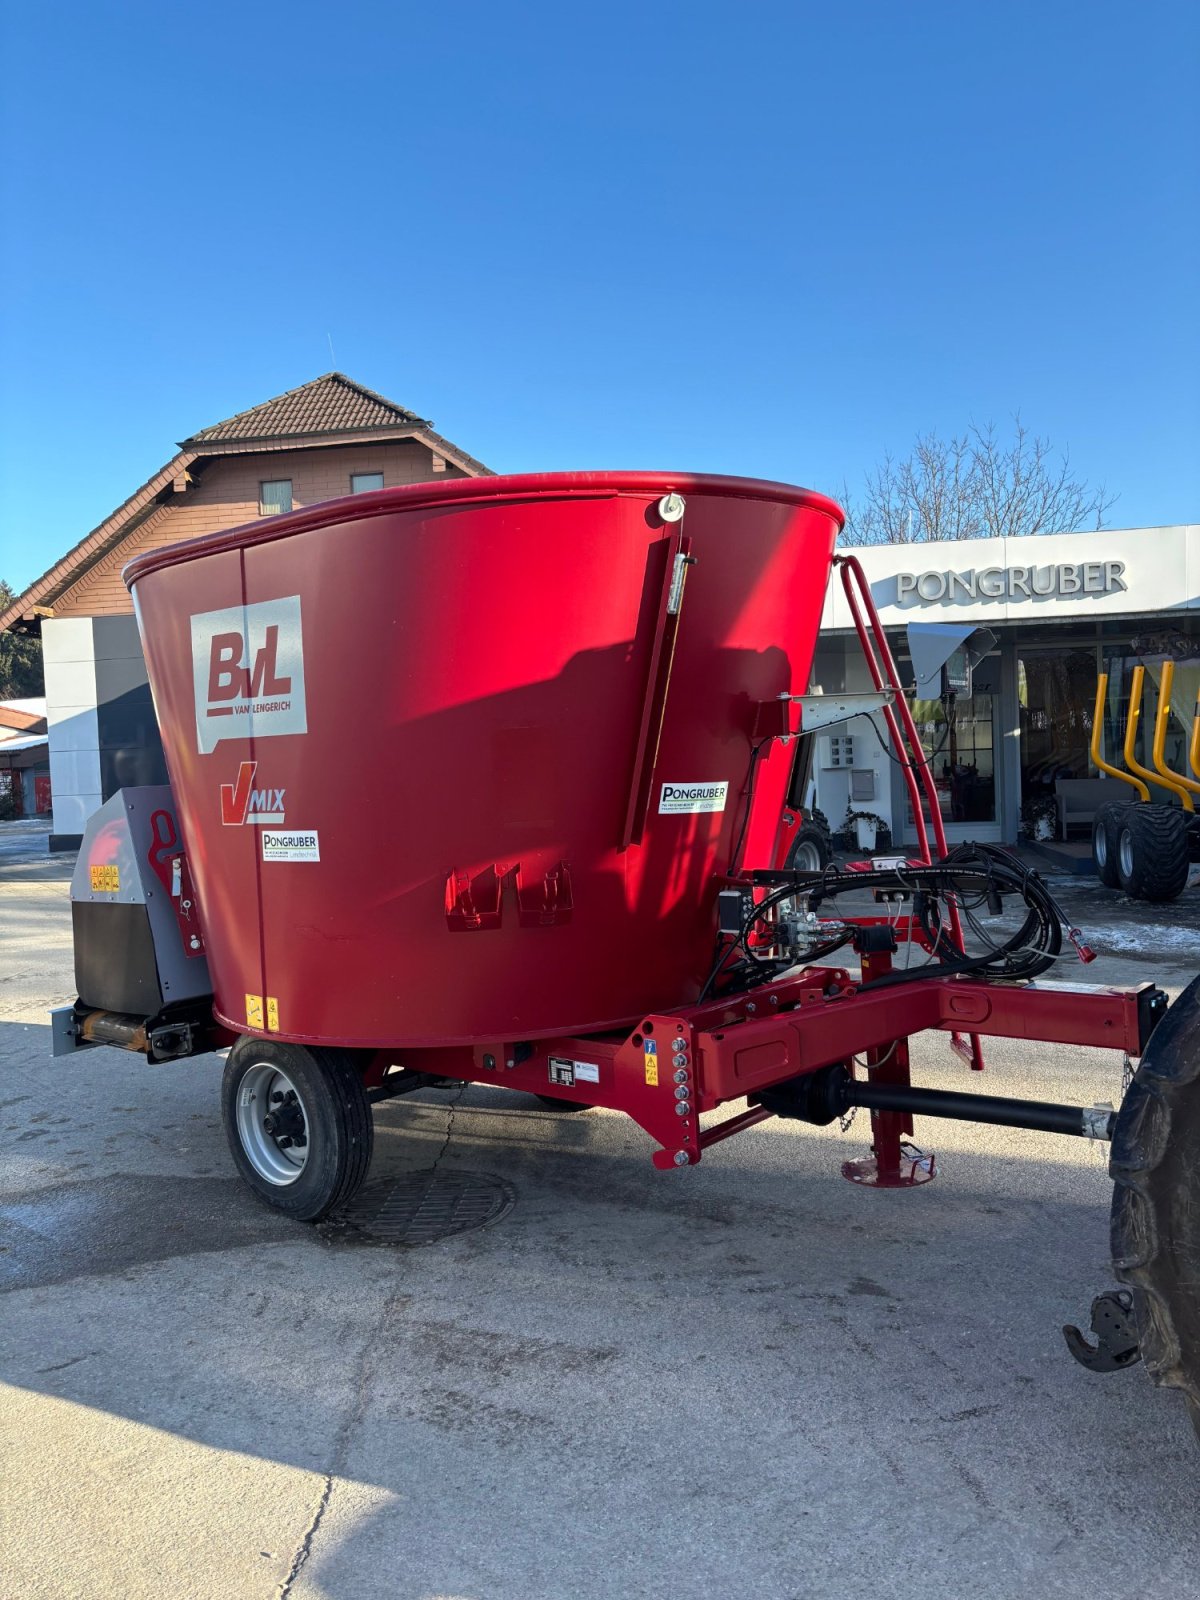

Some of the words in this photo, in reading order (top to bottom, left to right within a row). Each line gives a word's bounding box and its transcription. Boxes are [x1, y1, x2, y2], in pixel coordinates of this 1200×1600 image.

[898, 560, 1128, 602] PONGRUBER
[235, 705, 250, 714] VAN
[253, 701, 291, 713] LENGERICH
